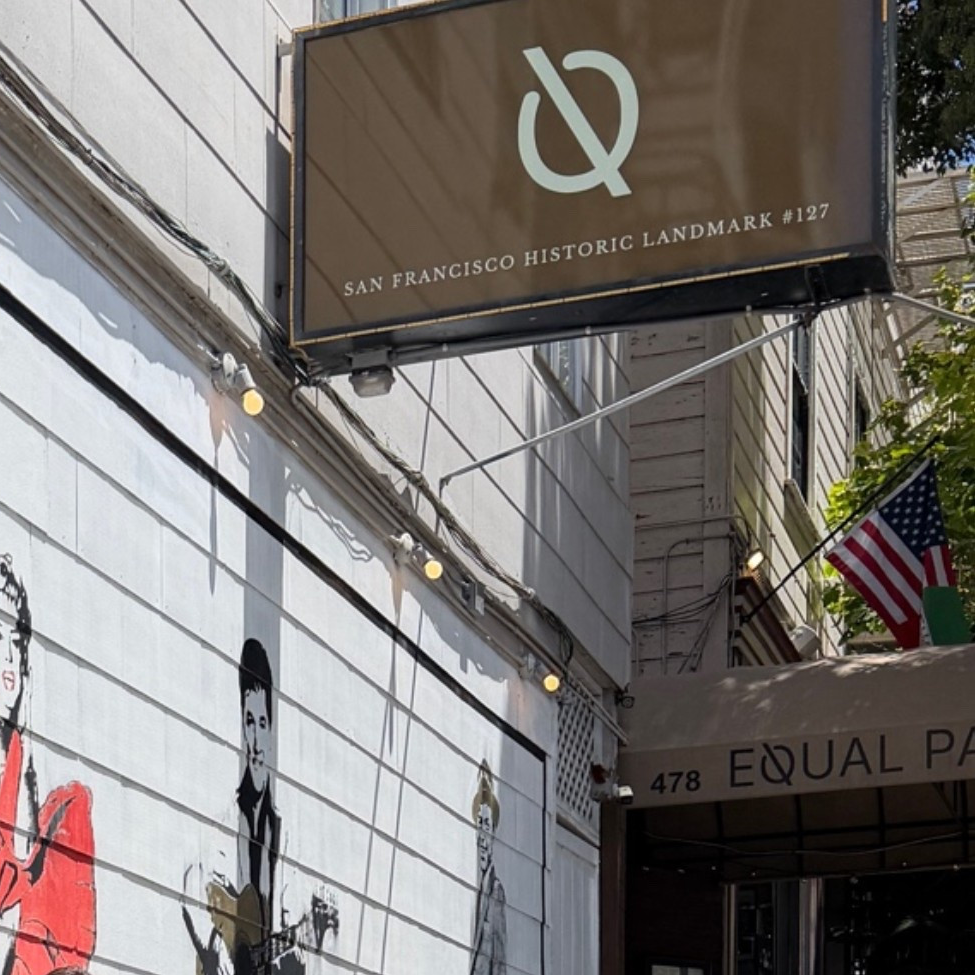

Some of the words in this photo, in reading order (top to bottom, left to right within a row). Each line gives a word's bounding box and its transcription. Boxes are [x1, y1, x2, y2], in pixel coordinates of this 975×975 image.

[344, 276, 383, 296] SAN
[392, 254, 515, 289] FRANCISCO
[524, 234, 633, 267] HISTORIC
[643, 212, 773, 248] LANDMARK
[782, 203, 829, 224] #127
[650, 770, 701, 794] 478
[729, 734, 903, 788] EQUAL
